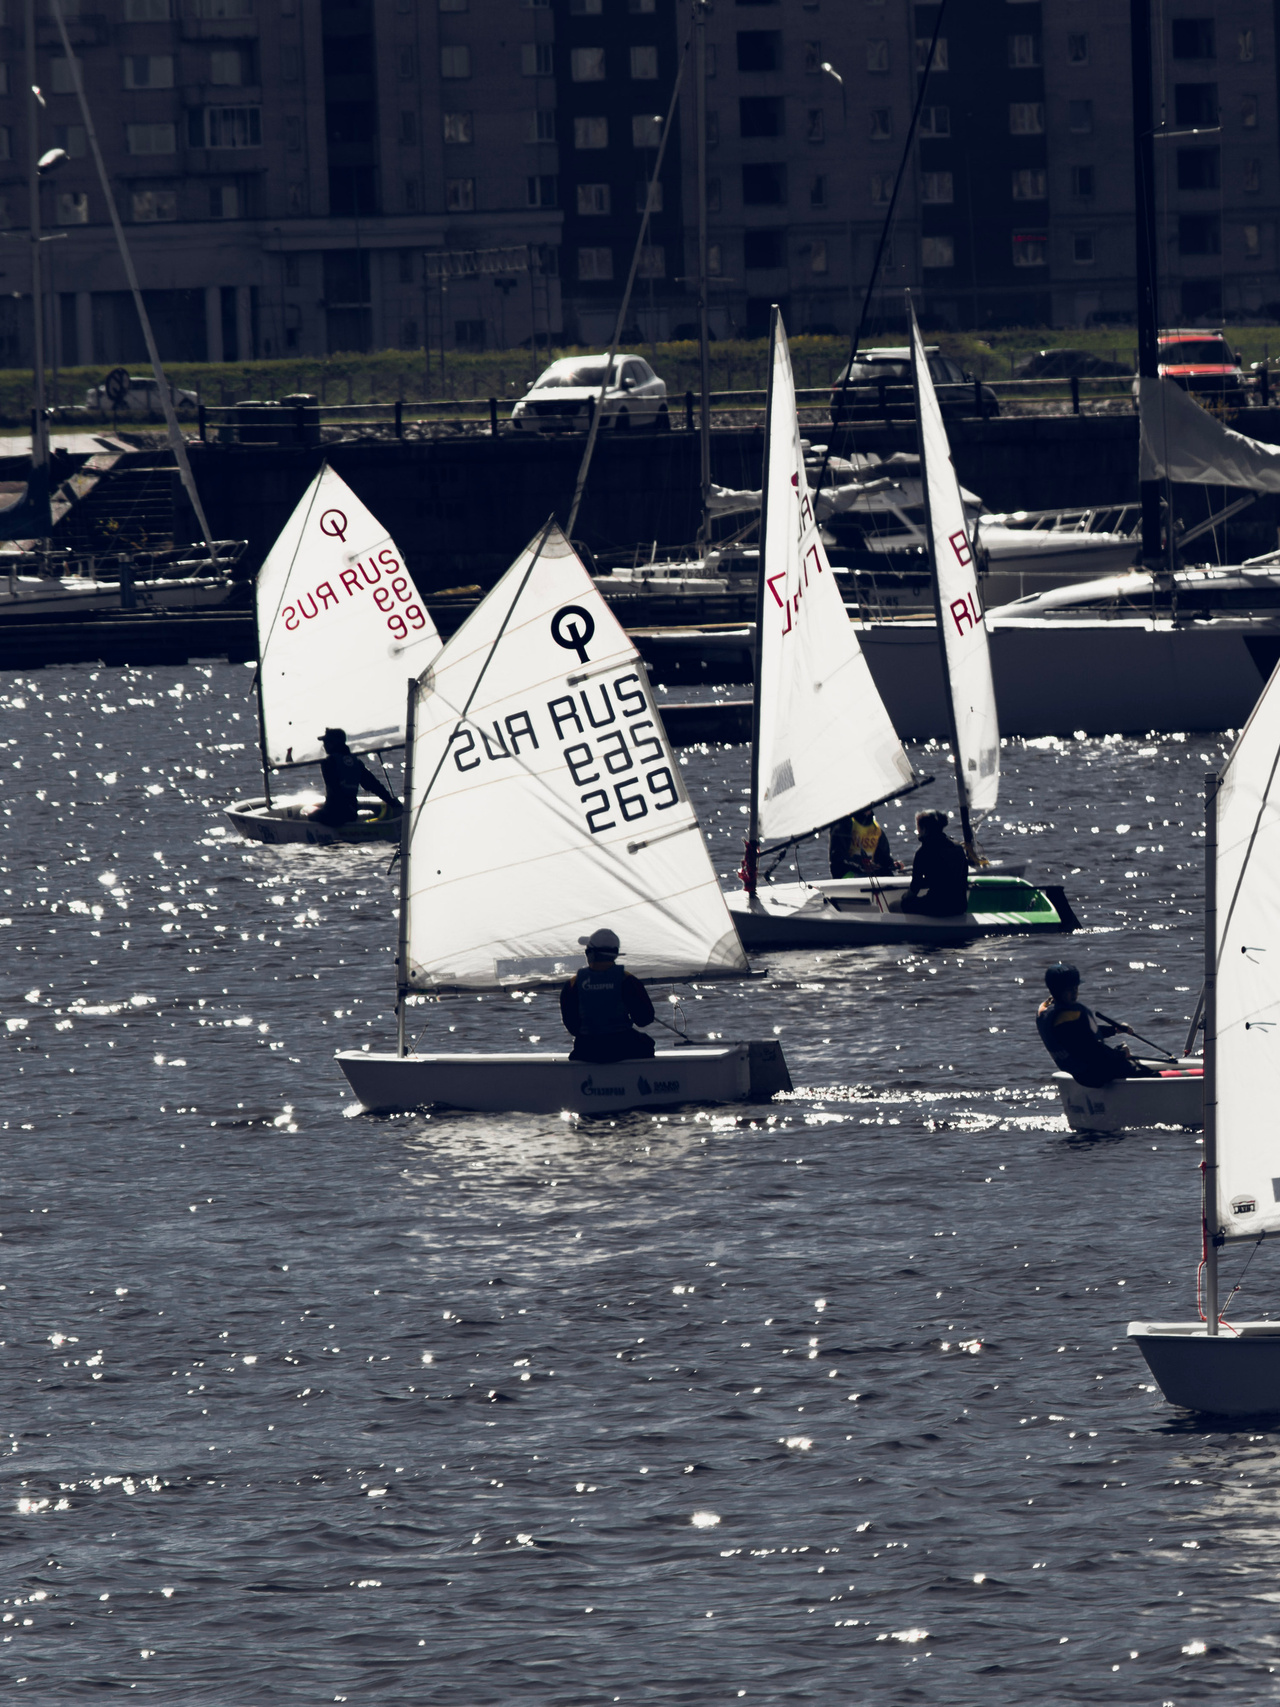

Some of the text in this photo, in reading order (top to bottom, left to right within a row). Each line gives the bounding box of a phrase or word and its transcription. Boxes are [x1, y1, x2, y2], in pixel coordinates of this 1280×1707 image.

[339, 550, 400, 597] RUS
[388, 605, 426, 640] 99
[547, 673, 648, 741] RUS
[581, 767, 680, 835] 269
